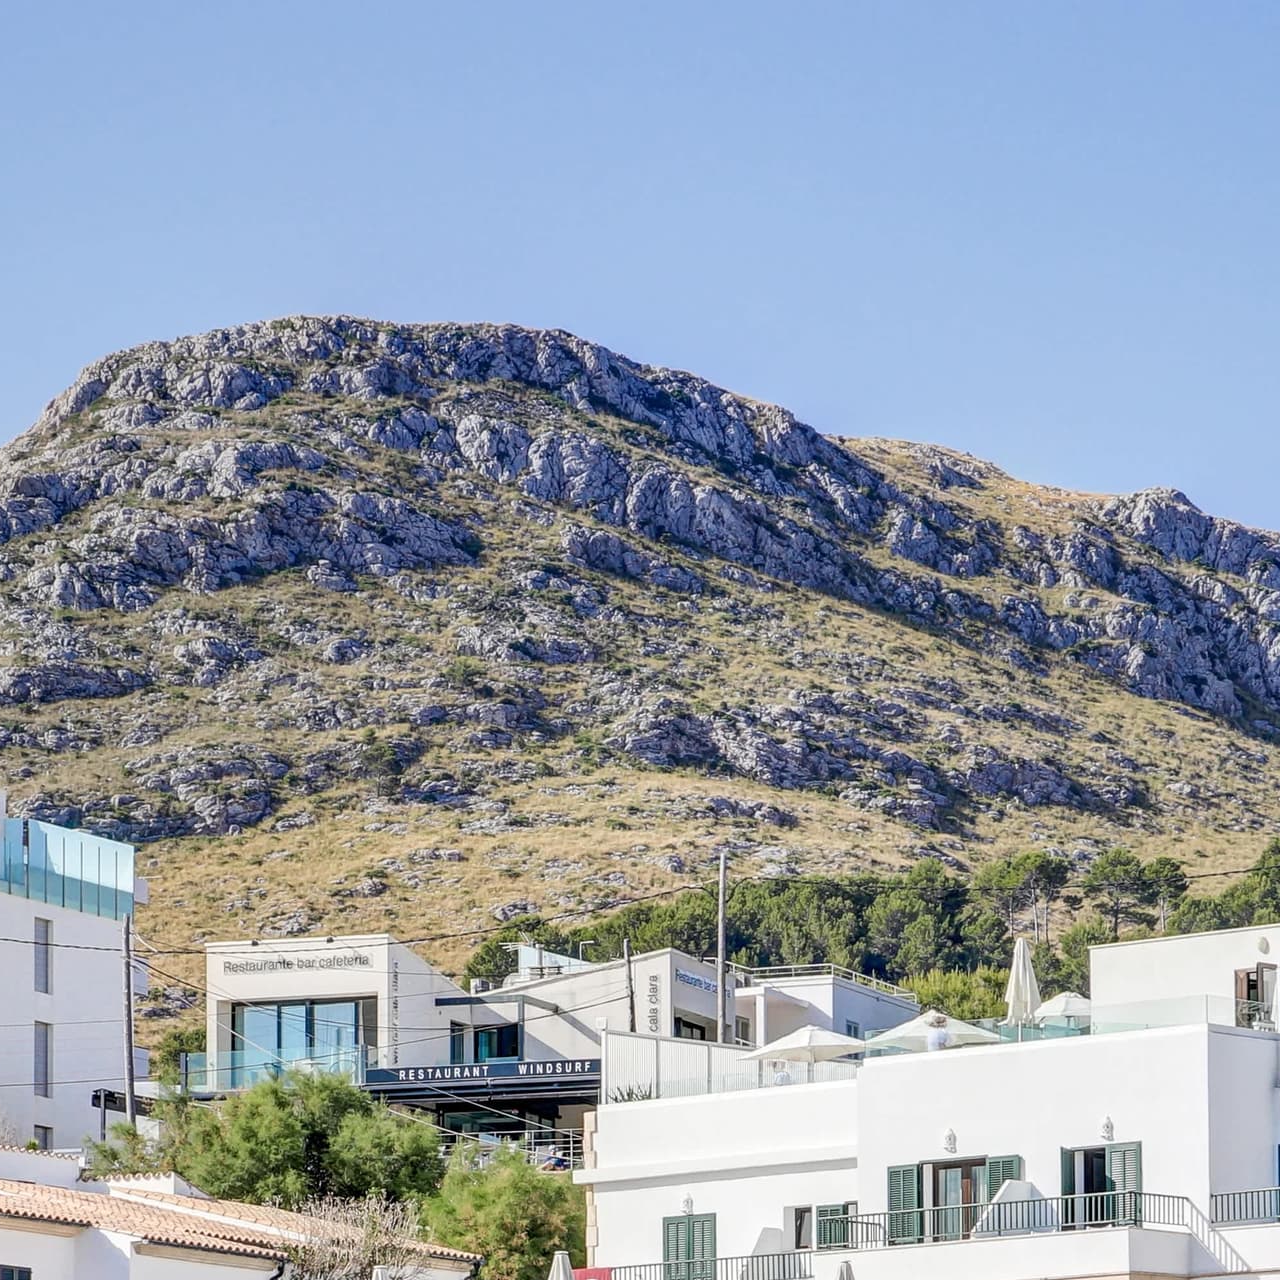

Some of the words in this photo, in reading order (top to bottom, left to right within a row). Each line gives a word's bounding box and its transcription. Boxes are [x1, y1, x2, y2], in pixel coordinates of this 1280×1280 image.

[223, 957, 293, 973] Restaurante
[297, 956, 316, 969] bar
[319, 953, 369, 968] cafeteria
[648, 975, 659, 1005] clara
[648, 1008, 659, 1032] cala
[399, 1066, 489, 1080] RESTAURANT
[518, 1061, 591, 1075] WINDSURF
